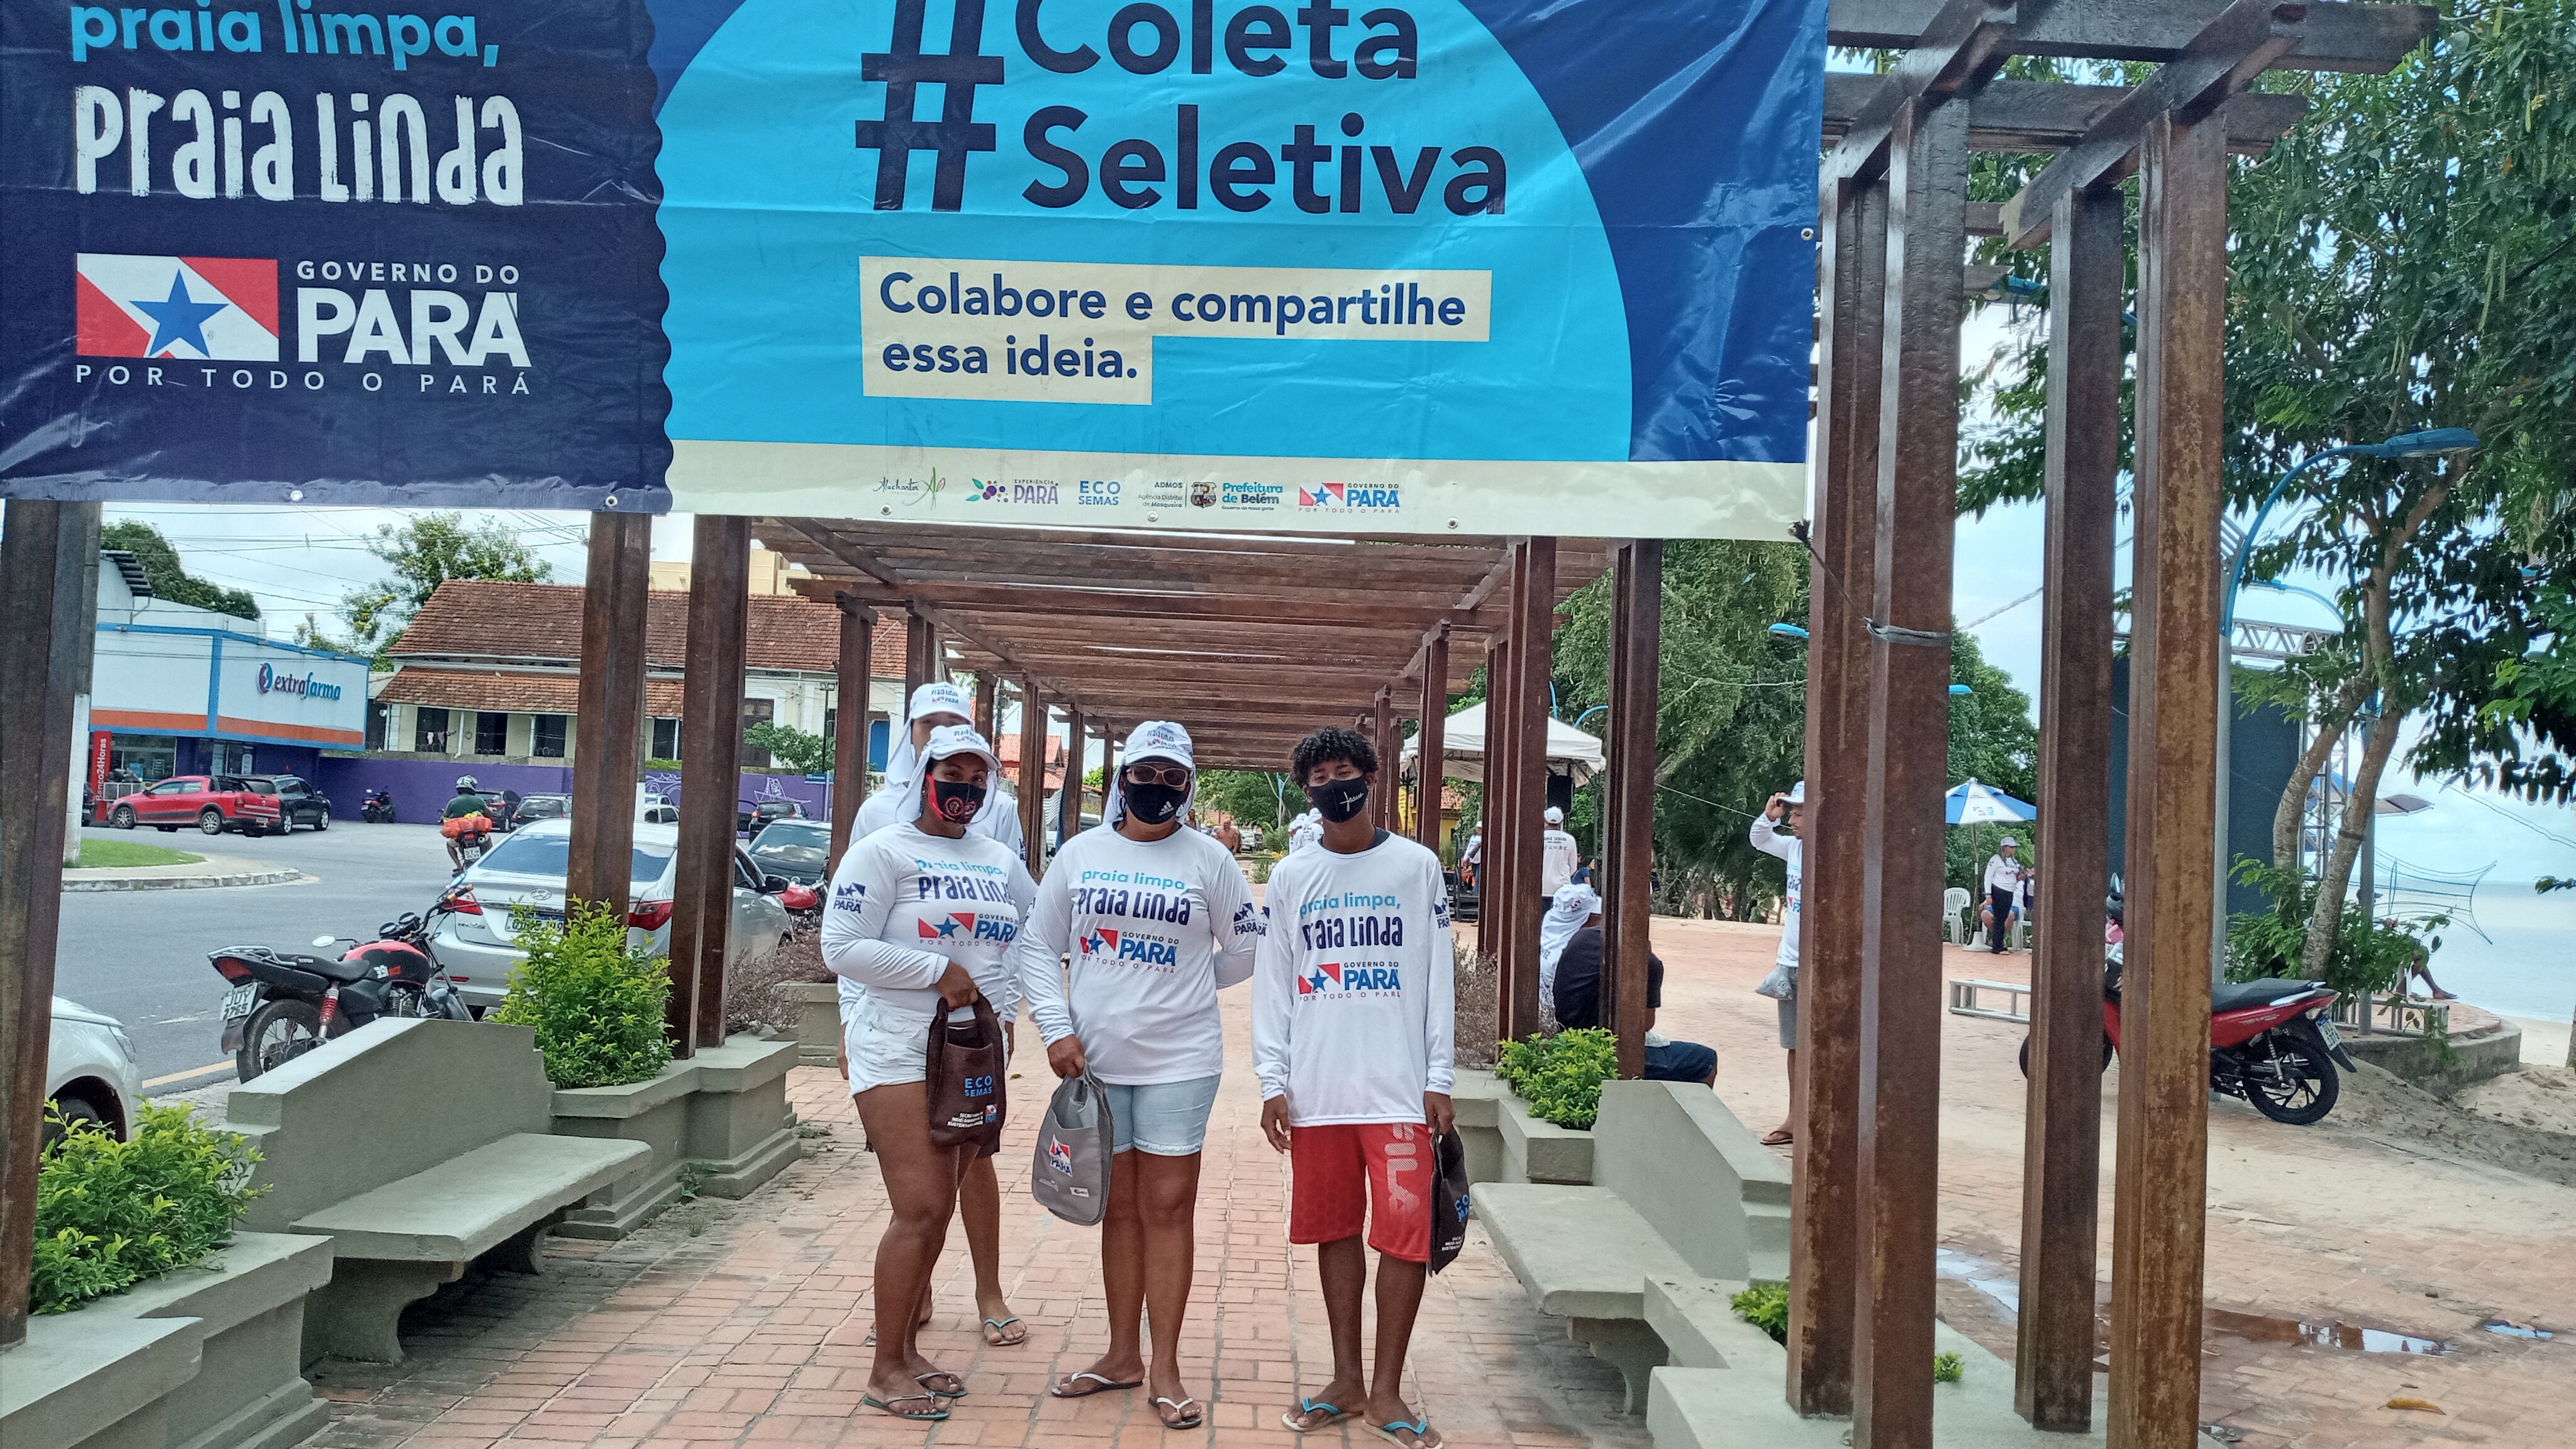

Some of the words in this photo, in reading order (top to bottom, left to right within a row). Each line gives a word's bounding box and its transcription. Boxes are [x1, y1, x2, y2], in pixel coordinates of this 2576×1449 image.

[70, 0, 262, 62] praia
[279, 0, 501, 70] limpa,
[297, 260, 458, 284] GOVERNO
[475, 264, 520, 285] DO
[880, 272, 1106, 321] Colabore
[1125, 289, 1153, 321] e
[1171, 283, 1466, 335] compartilhe
[882, 345, 989, 375] essa
[1007, 334, 1138, 379] ideia.
[75, 364, 163, 387] POR
[201, 367, 325, 391] TODO
[362, 372, 382, 392] O
[420, 371, 531, 395] PARÁ
[1080, 480, 1121, 495] ECO
[1223, 482, 1283, 494] Prefeitura
[1079, 496, 1119, 506] SEMAS
[1222, 492, 1238, 503] de
[1241, 492, 1279, 504] Belém
[274, 671, 341, 701] extrafarma
[1081, 870, 1130, 884] praia
[1299, 894, 1340, 920] praia
[1344, 892, 1401, 910] limpa,
[979, 913, 1014, 923] GOVERNO
[1122, 931, 1165, 942] GOVERNO
[1096, 957, 1125, 967] TODO
[226, 991, 251, 1008] JUY
[223, 1002, 248, 1020] 2765
[965, 1075, 992, 1089] ECO
[964, 1086, 992, 1097] SEMAS
